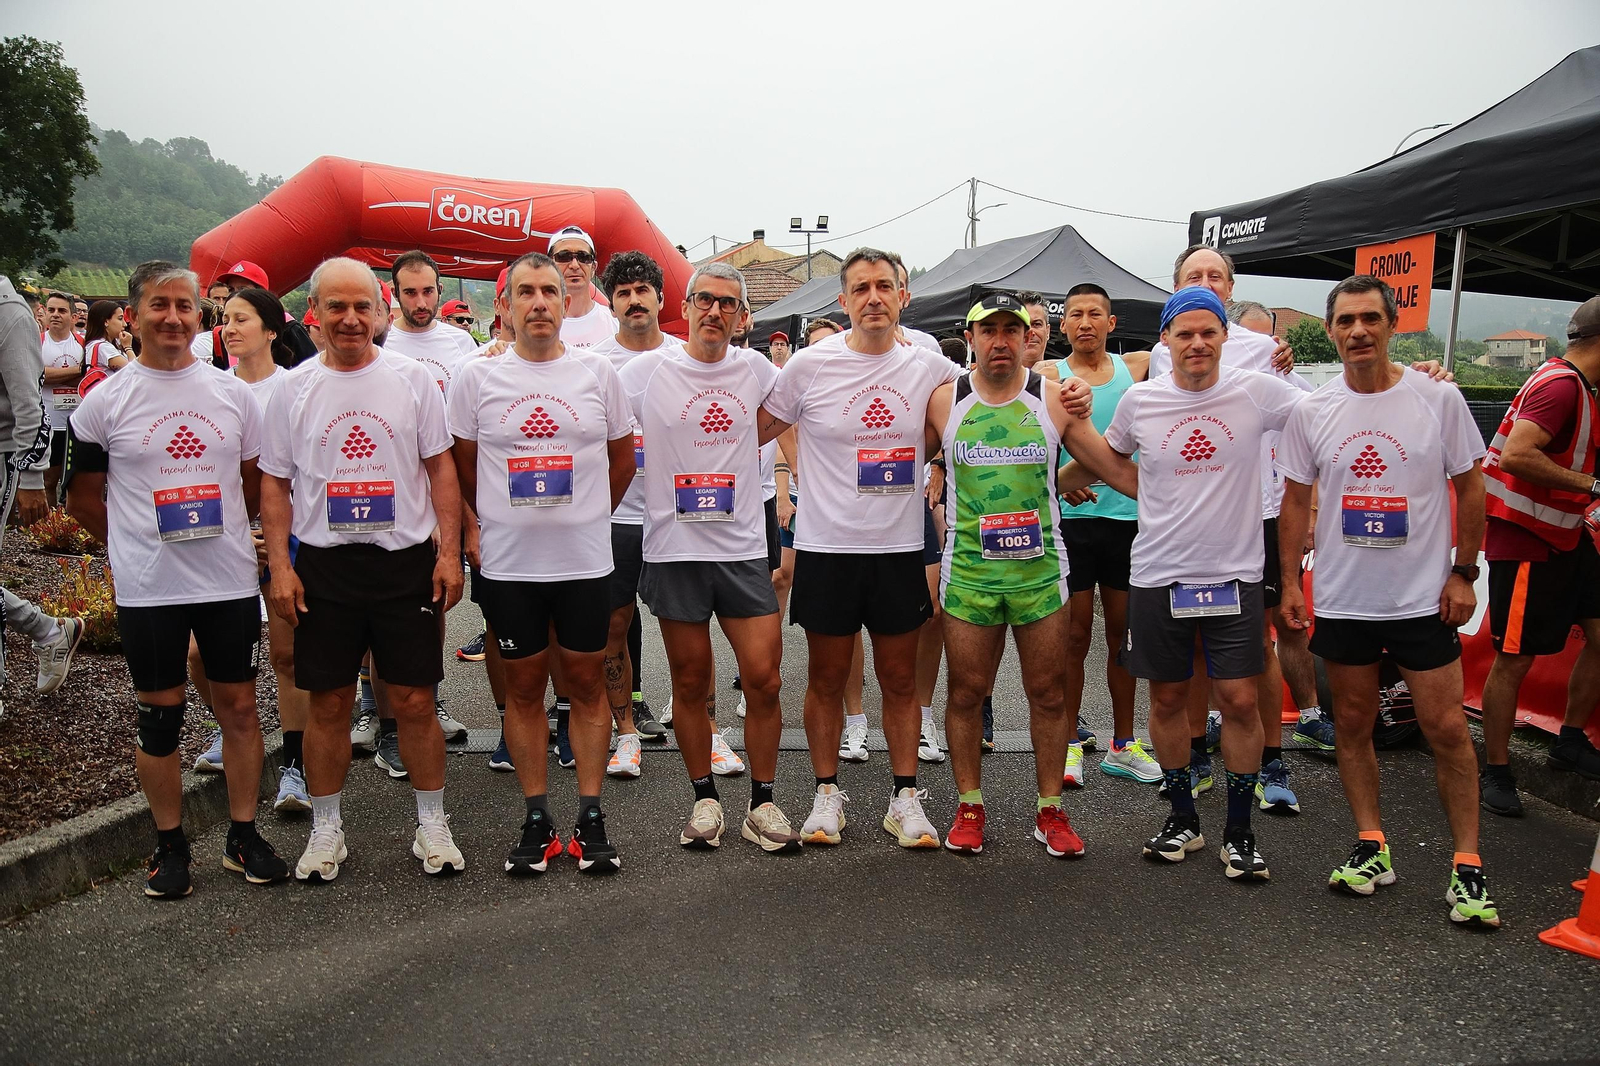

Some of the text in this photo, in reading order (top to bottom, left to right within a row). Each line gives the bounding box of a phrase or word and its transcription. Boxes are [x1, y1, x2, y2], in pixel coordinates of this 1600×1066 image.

[1221, 216, 1267, 239] CCNORTE
[1370, 250, 1417, 278] CRONO-
[426, 358, 452, 381] CAMPEIRA
[506, 393, 541, 414] ANDAINA
[544, 393, 580, 422] CAMPEIRA
[685, 389, 715, 410] ANDAINA
[717, 389, 748, 416] CAMPEIRA
[848, 384, 880, 406] ANDAINA
[881, 384, 911, 412] CAMPEIRA
[149, 410, 185, 434] ANDAINA
[187, 410, 225, 441] CAMPEIRA
[324, 410, 358, 435] ANDAINA
[360, 410, 394, 440] CAMPEIRA
[1166, 415, 1199, 439] ANDAINA
[1201, 414, 1234, 442] CAMPEIRA
[955, 441, 1047, 465] Natursueño
[1338, 429, 1373, 452] ANDAINA
[1375, 430, 1408, 462] CAMPEIRA
[535, 480, 546, 493] 8
[884, 470, 893, 482] 6
[166, 492, 179, 500] GSI
[697, 496, 716, 508] 22
[188, 511, 200, 524] 3
[351, 506, 371, 519] 17
[1364, 520, 1384, 534] 13
[997, 534, 1031, 548] 1003
[1195, 591, 1213, 603] 11
